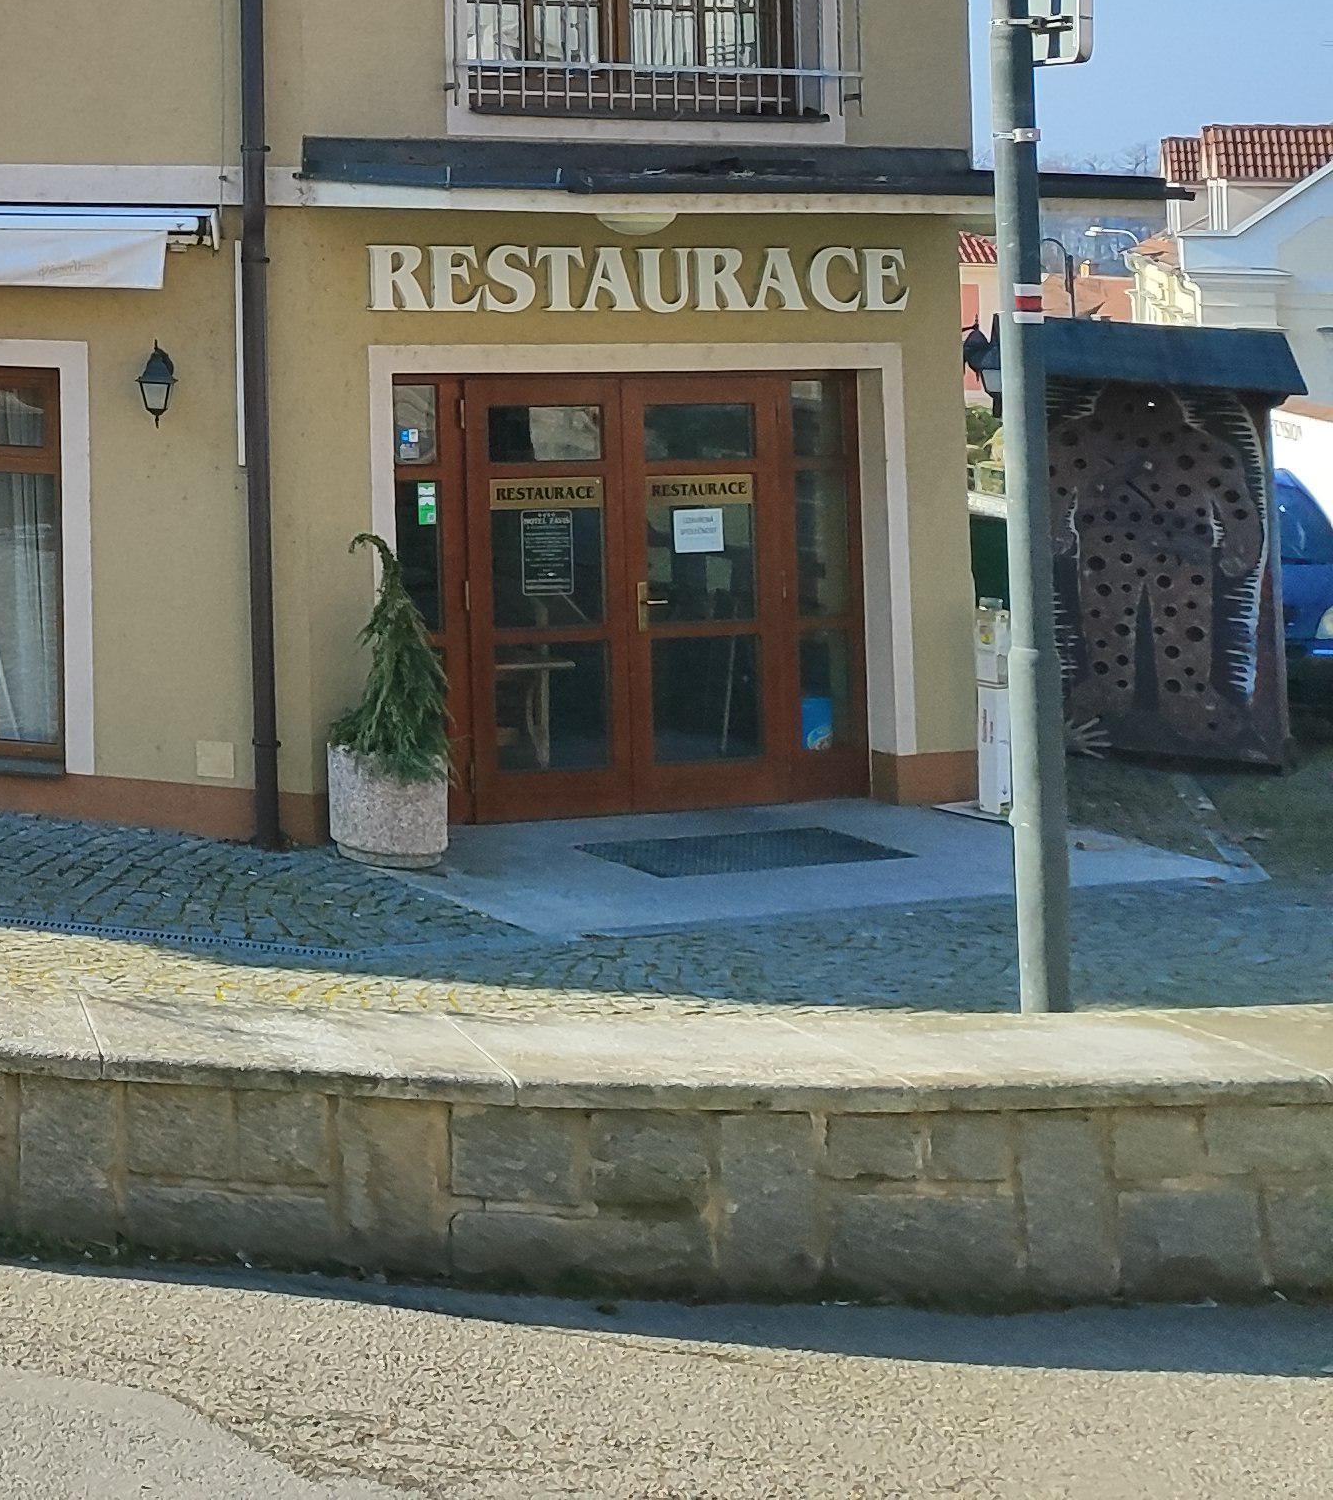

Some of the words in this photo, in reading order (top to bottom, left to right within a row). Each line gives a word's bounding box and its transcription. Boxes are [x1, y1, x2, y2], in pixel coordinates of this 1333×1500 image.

[365, 244, 910, 314] RESTAURACE
[496, 485, 595, 501] RESTAURACE
[651, 481, 748, 497] RESTAURACE
